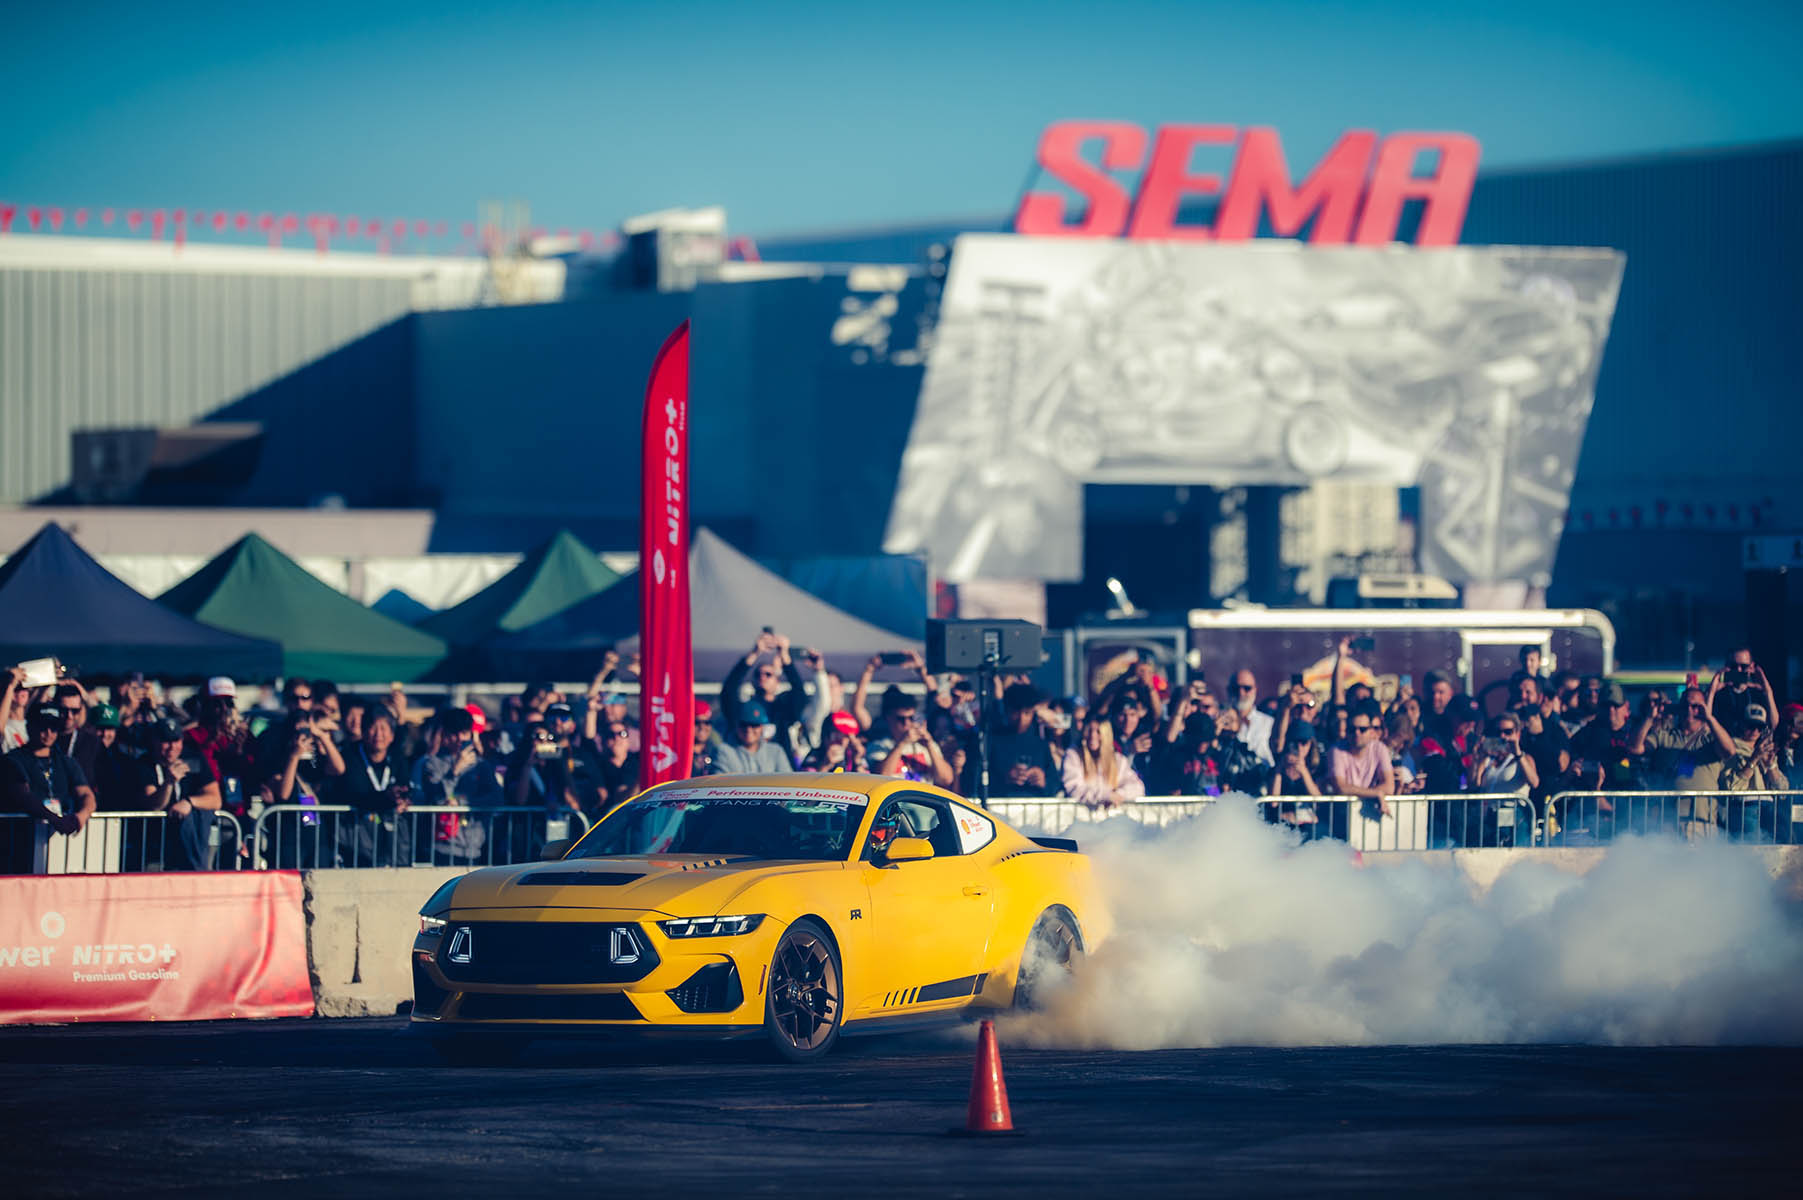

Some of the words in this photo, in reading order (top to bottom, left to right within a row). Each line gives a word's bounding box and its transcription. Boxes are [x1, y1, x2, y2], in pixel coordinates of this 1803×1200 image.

[1014, 121, 1482, 247] SEMA
[706, 789, 791, 797] Performance
[72, 971, 126, 982] Premium
[128, 968, 180, 981] Gasoline
